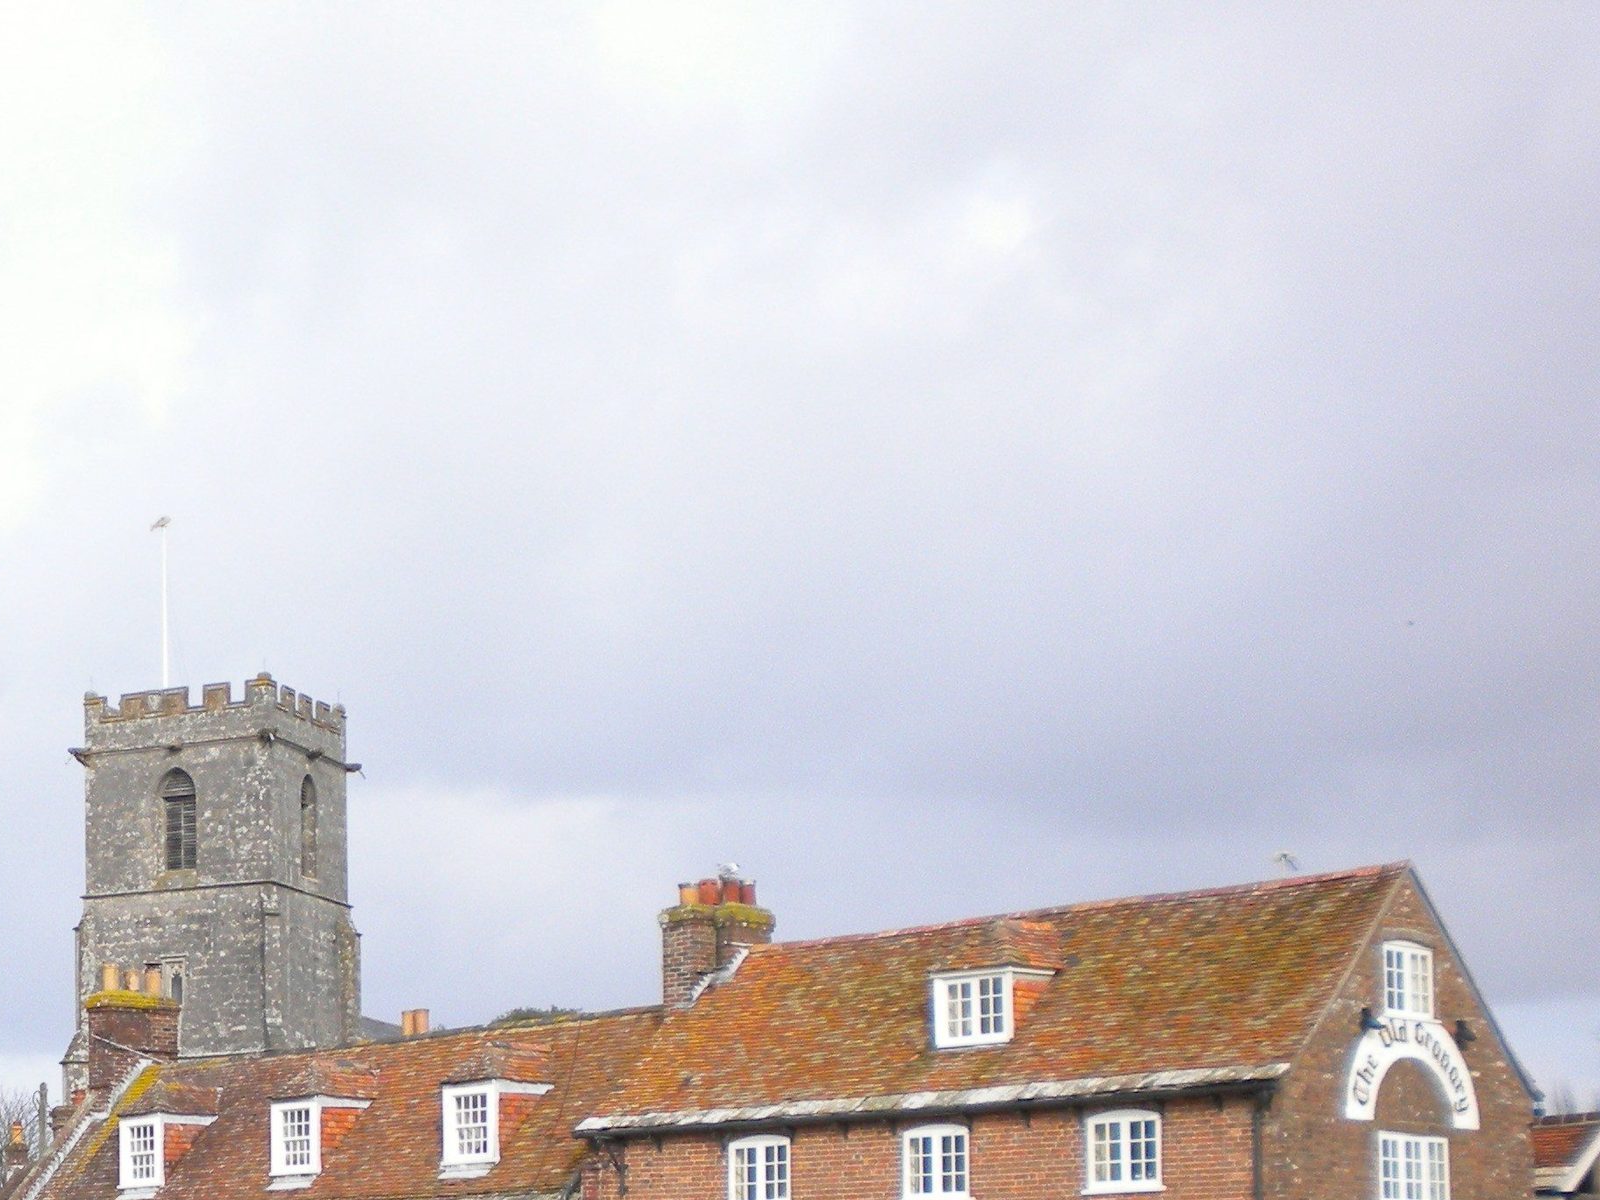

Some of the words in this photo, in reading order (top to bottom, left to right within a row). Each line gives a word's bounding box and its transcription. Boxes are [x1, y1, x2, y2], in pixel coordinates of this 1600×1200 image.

[1353, 1053, 1379, 1106] The
[1379, 1018, 1408, 1048] Old
[1414, 1022, 1470, 1113] Granary
